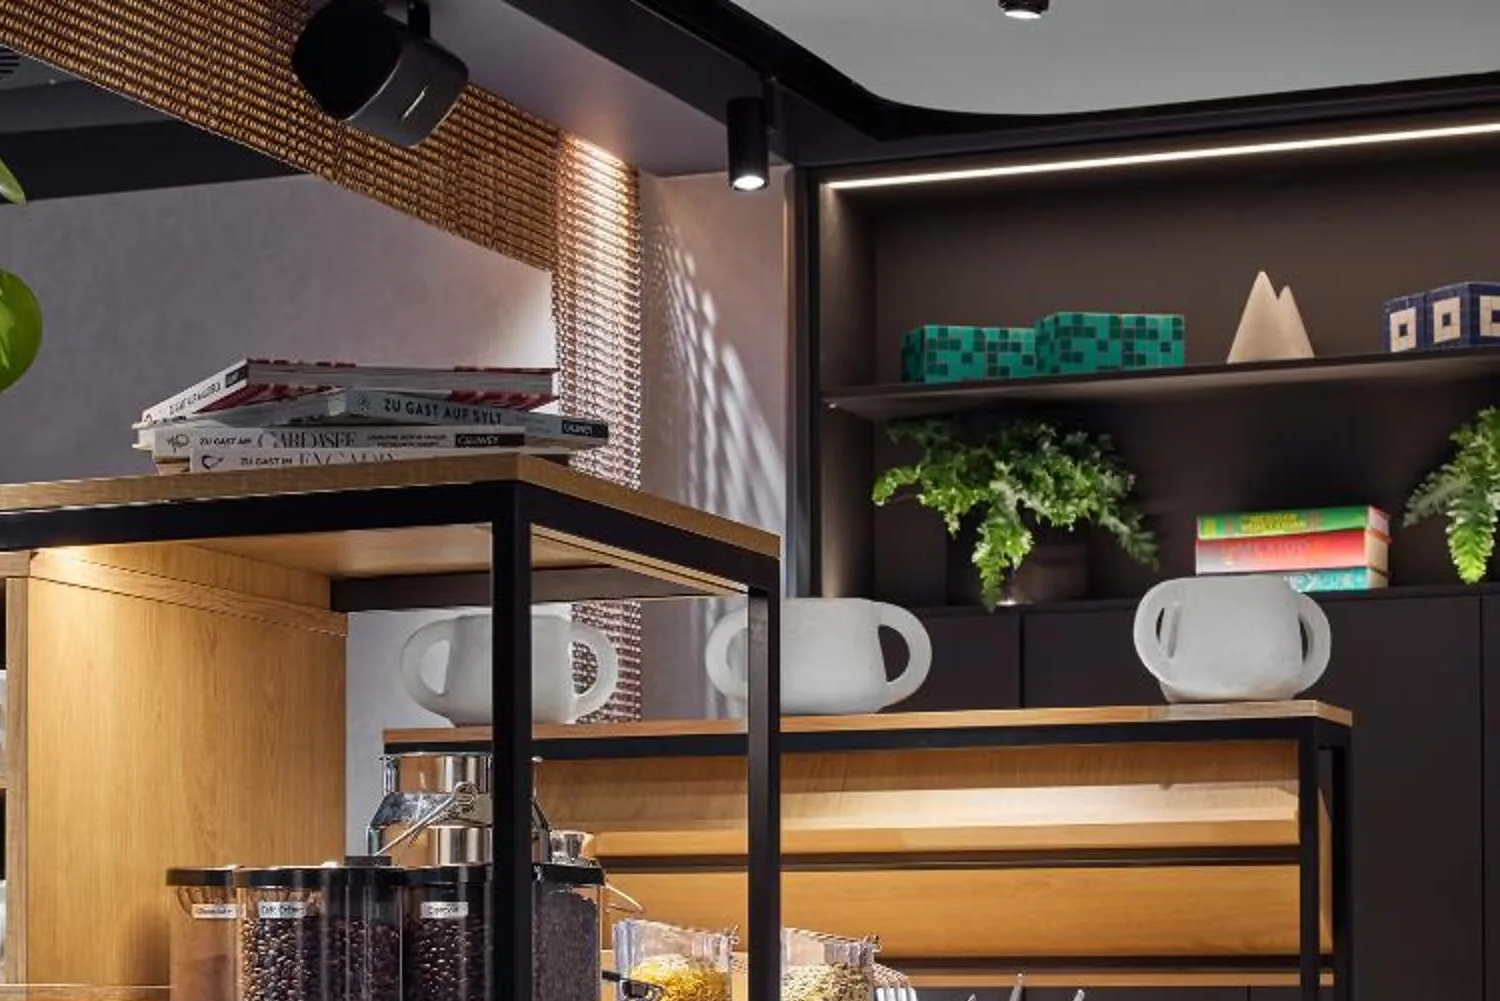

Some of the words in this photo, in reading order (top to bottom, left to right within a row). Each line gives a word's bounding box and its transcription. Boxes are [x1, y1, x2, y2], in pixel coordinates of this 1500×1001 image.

[385, 399, 401, 413] ZU
[405, 401, 439, 417] GAST
[443, 405, 469, 420] AUF
[473, 408, 502, 425] SYLT
